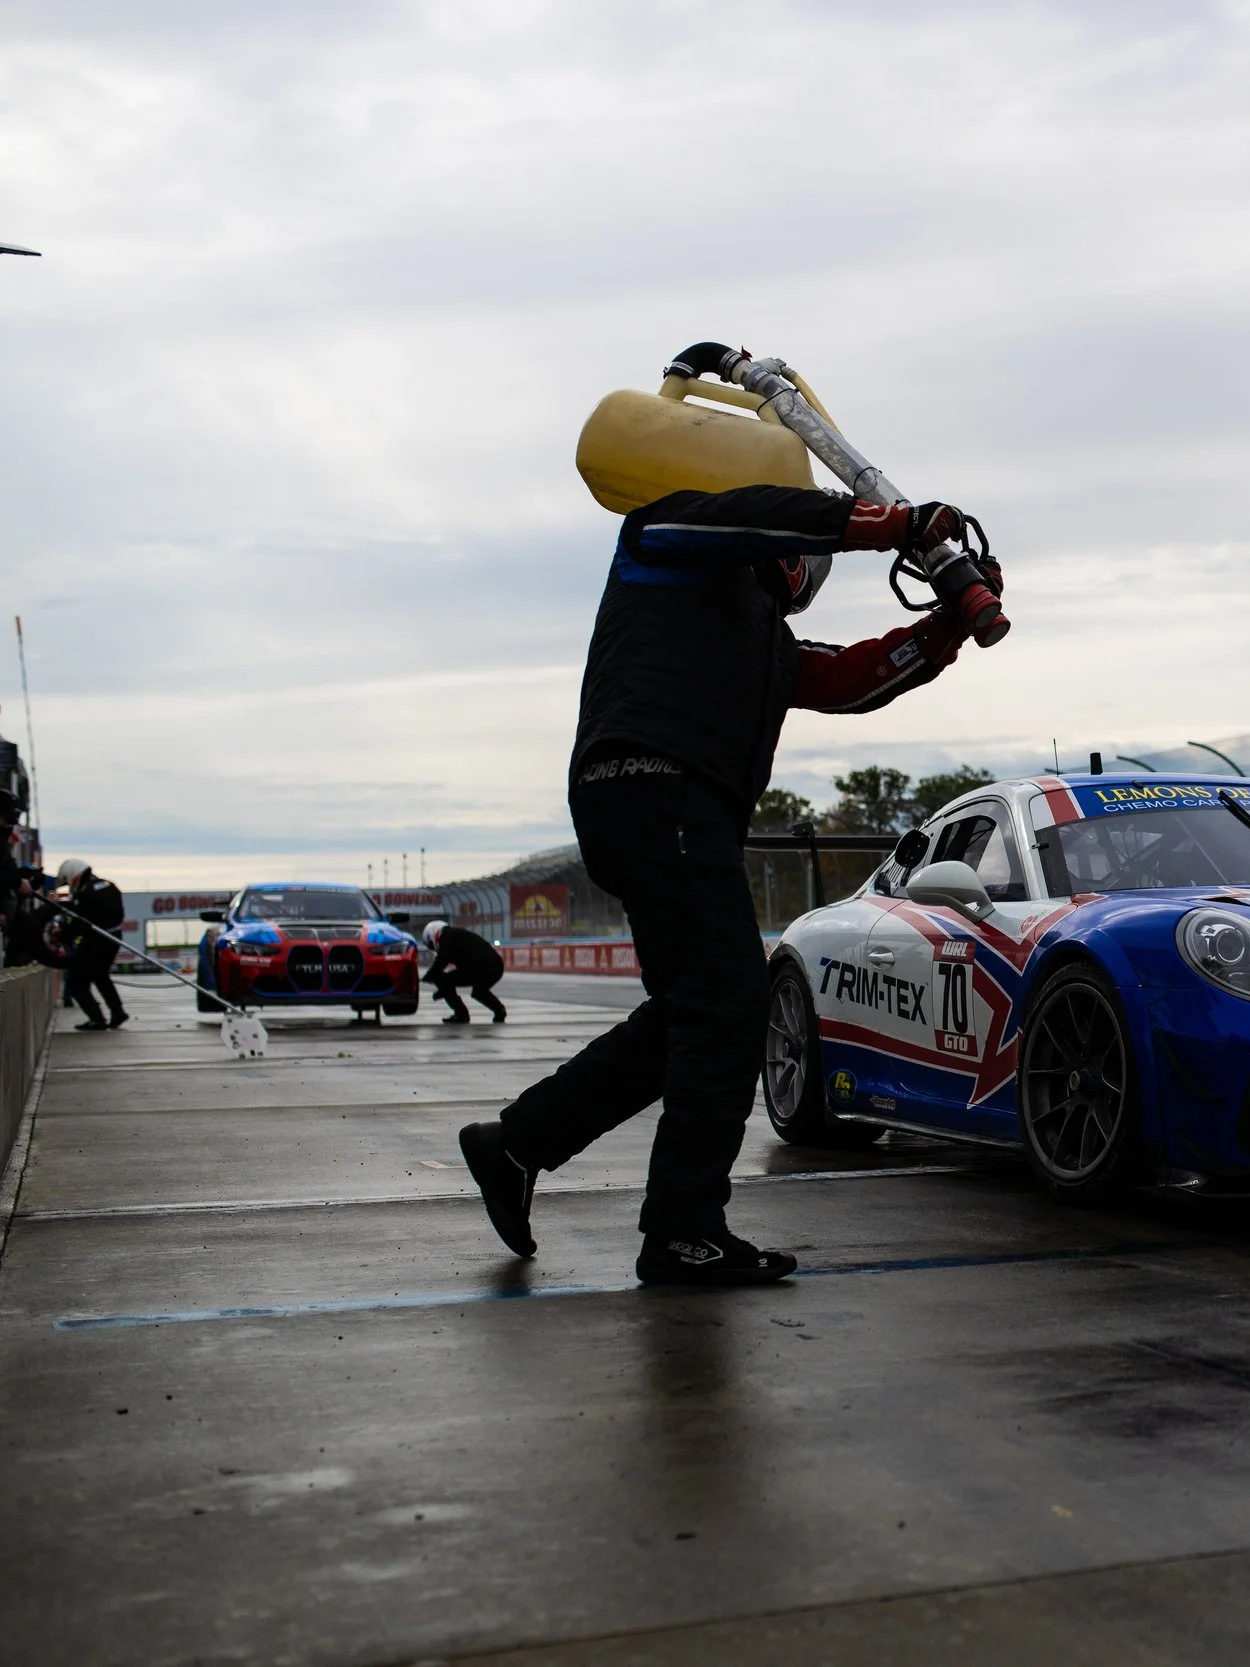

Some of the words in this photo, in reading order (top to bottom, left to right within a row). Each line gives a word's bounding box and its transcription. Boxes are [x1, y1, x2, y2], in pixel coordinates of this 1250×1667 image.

[1094, 785, 1212, 803] LEMONS
[1103, 799, 1177, 812] CHEMO
[941, 941, 969, 957] WRL
[819, 956, 928, 1026] TRIM-TEX
[938, 962, 968, 1034] 70
[944, 1034, 969, 1052] GTO
